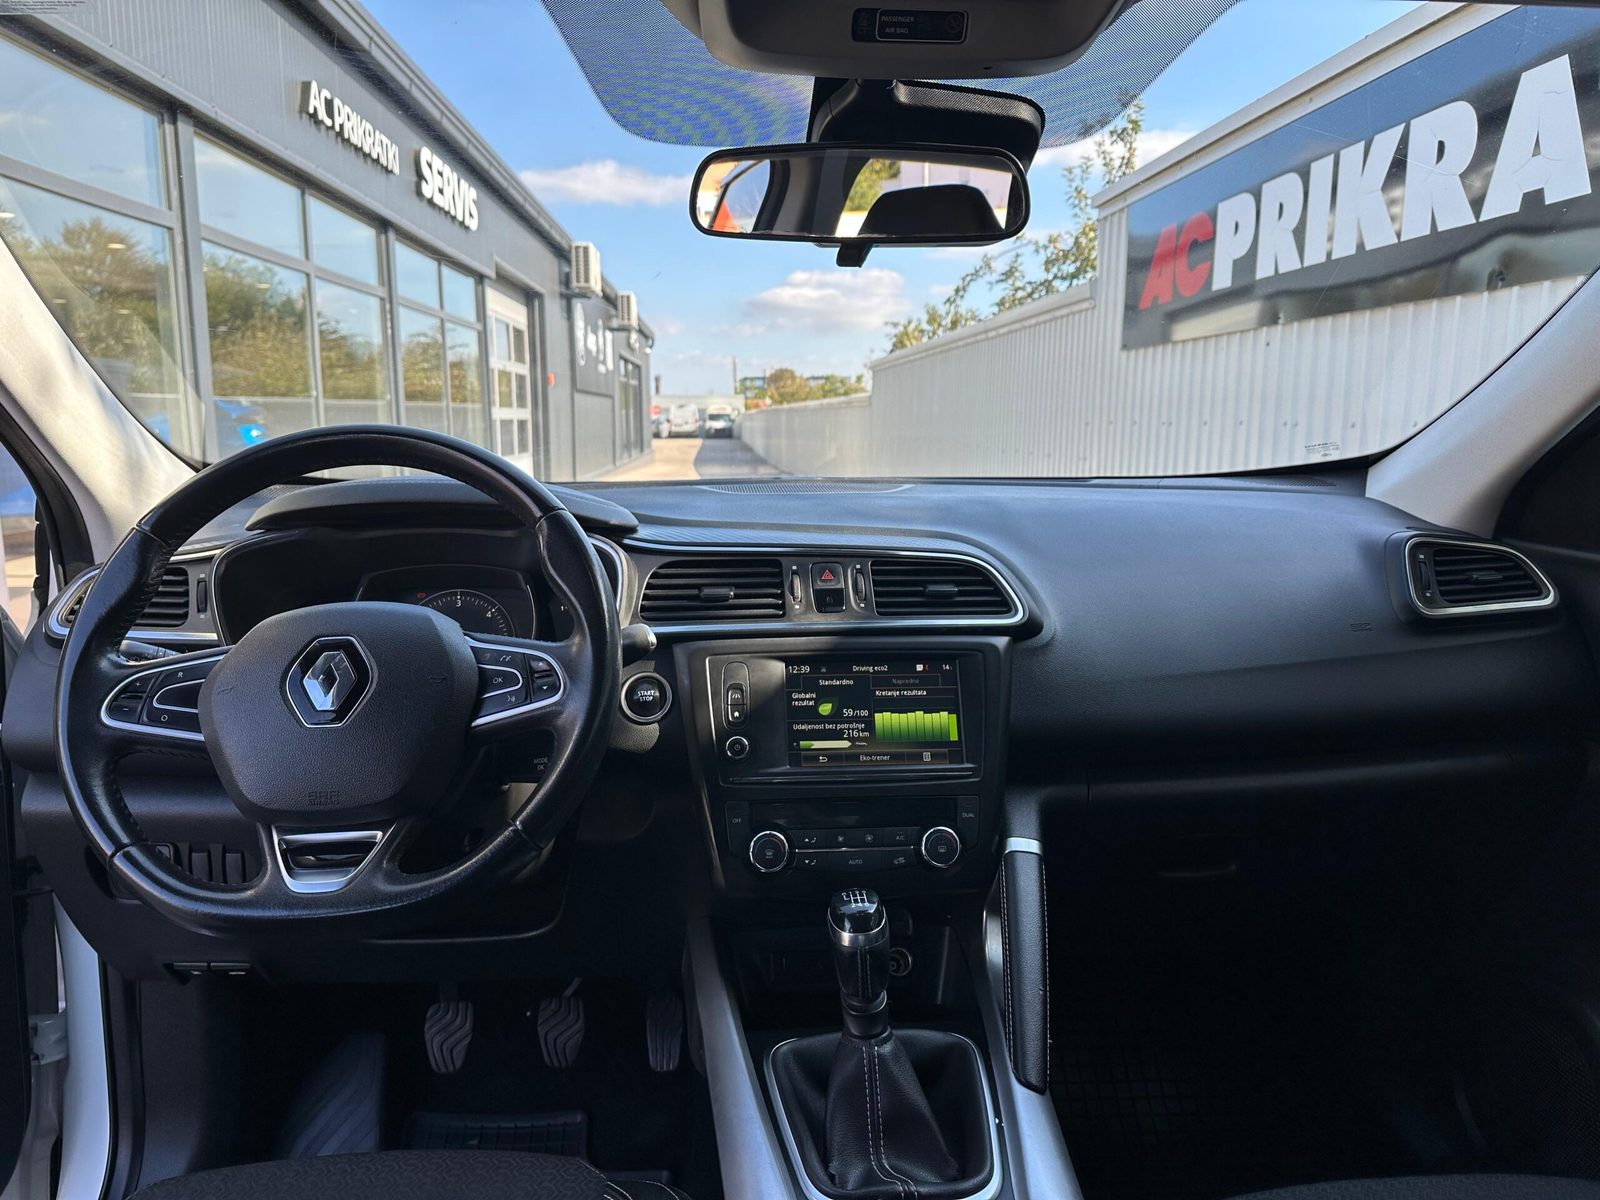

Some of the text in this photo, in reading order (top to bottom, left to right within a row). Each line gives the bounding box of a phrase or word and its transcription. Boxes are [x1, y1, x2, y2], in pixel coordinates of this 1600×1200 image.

[308, 79, 400, 176] AC PRIKRATKI
[420, 146, 479, 231] SERVIS
[456, 600, 462, 608] 3
[788, 665, 810, 674] 12:39
[852, 665, 874, 673] Driving
[493, 676, 504, 684] OK
[639, 695, 654, 703] STOP
[793, 723, 825, 731] Udaljenost
[837, 722, 865, 731] potrošnje
[843, 729, 859, 738] 216
[848, 858, 864, 866] AUTO
